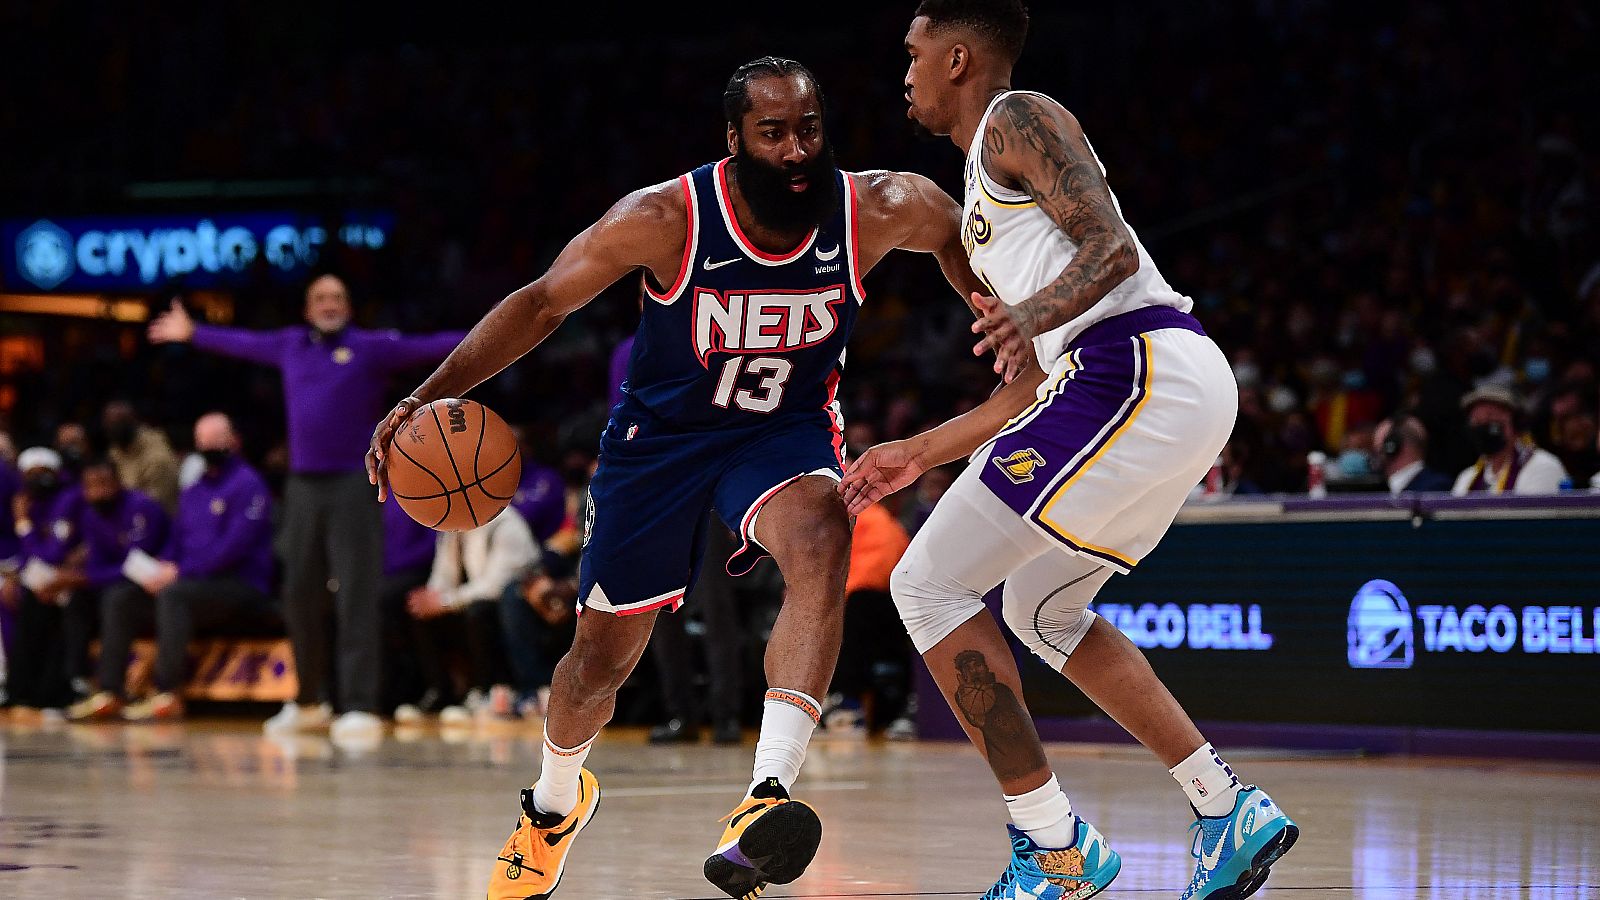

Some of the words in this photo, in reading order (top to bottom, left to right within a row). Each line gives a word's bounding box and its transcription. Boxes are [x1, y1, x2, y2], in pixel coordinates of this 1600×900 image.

[815, 264, 840, 274] Webull
[693, 285, 844, 363] NETS
[712, 356, 793, 414] 13
[1187, 603, 1273, 650] BELL
[1416, 604, 1518, 652] TACO
[1522, 605, 1600, 654] BEL
